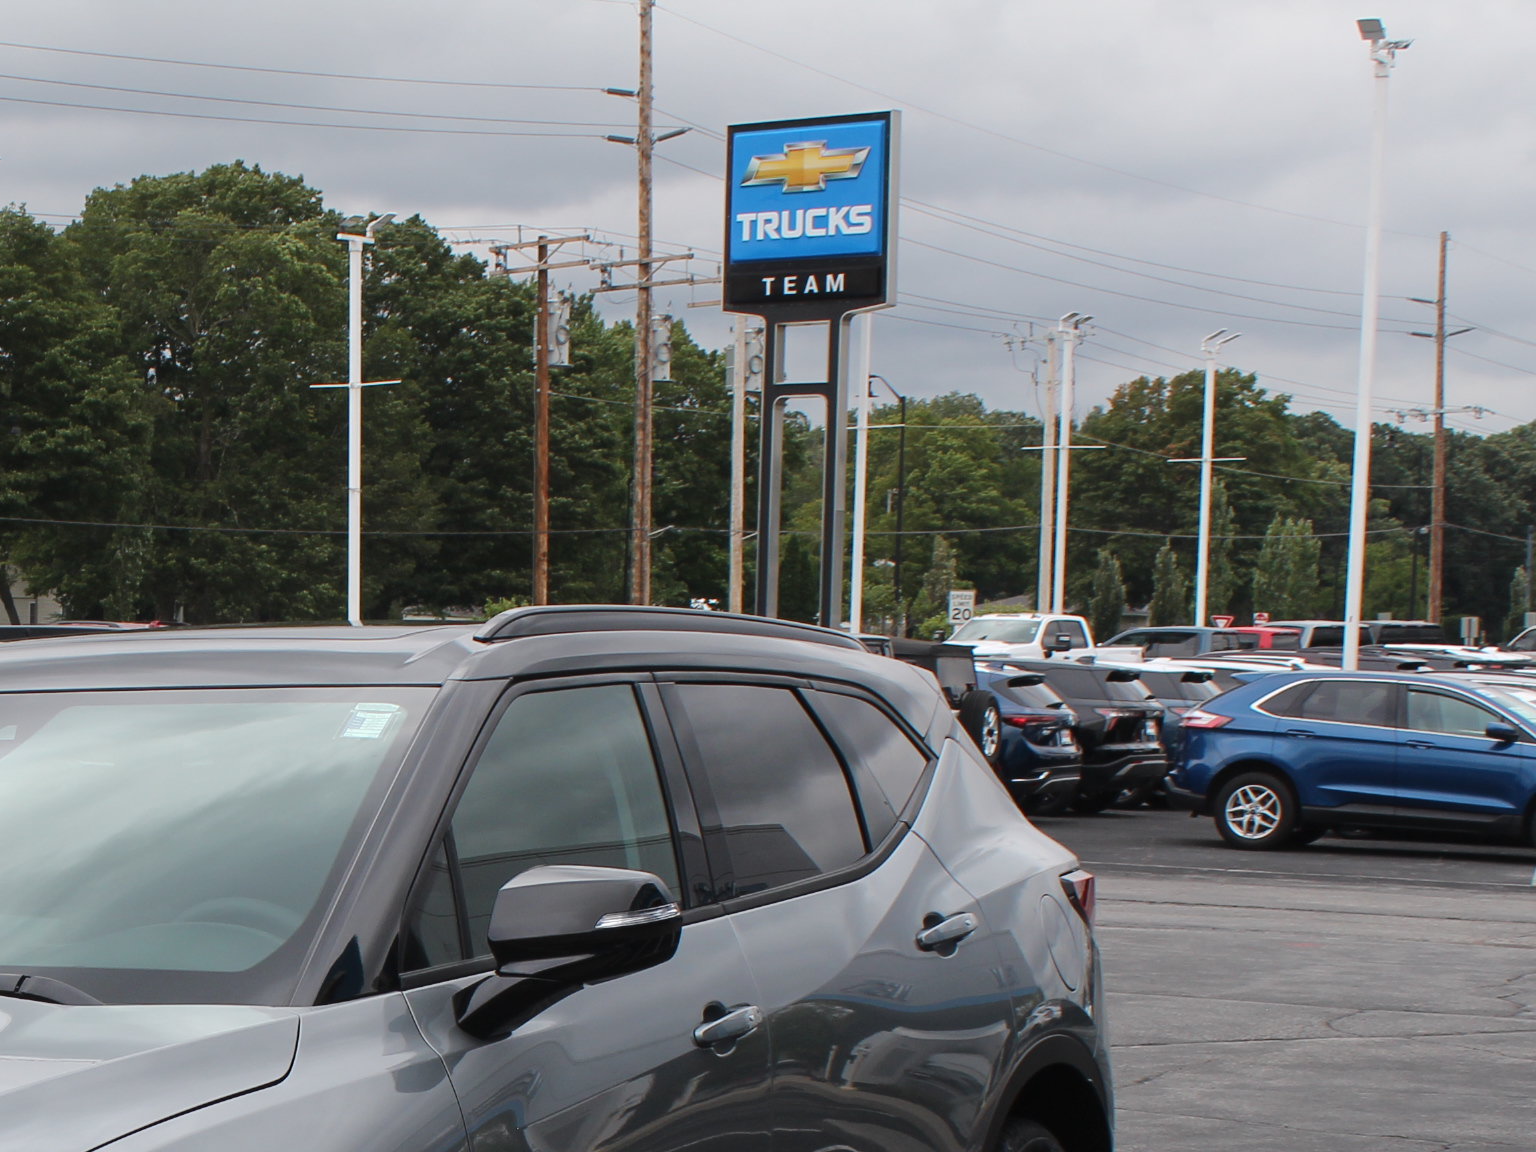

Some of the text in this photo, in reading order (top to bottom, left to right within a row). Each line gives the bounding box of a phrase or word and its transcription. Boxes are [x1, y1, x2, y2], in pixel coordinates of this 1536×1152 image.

[735, 204, 873, 242] TRUCKS
[762, 273, 846, 297] TEAM
[951, 607, 972, 620] 20
